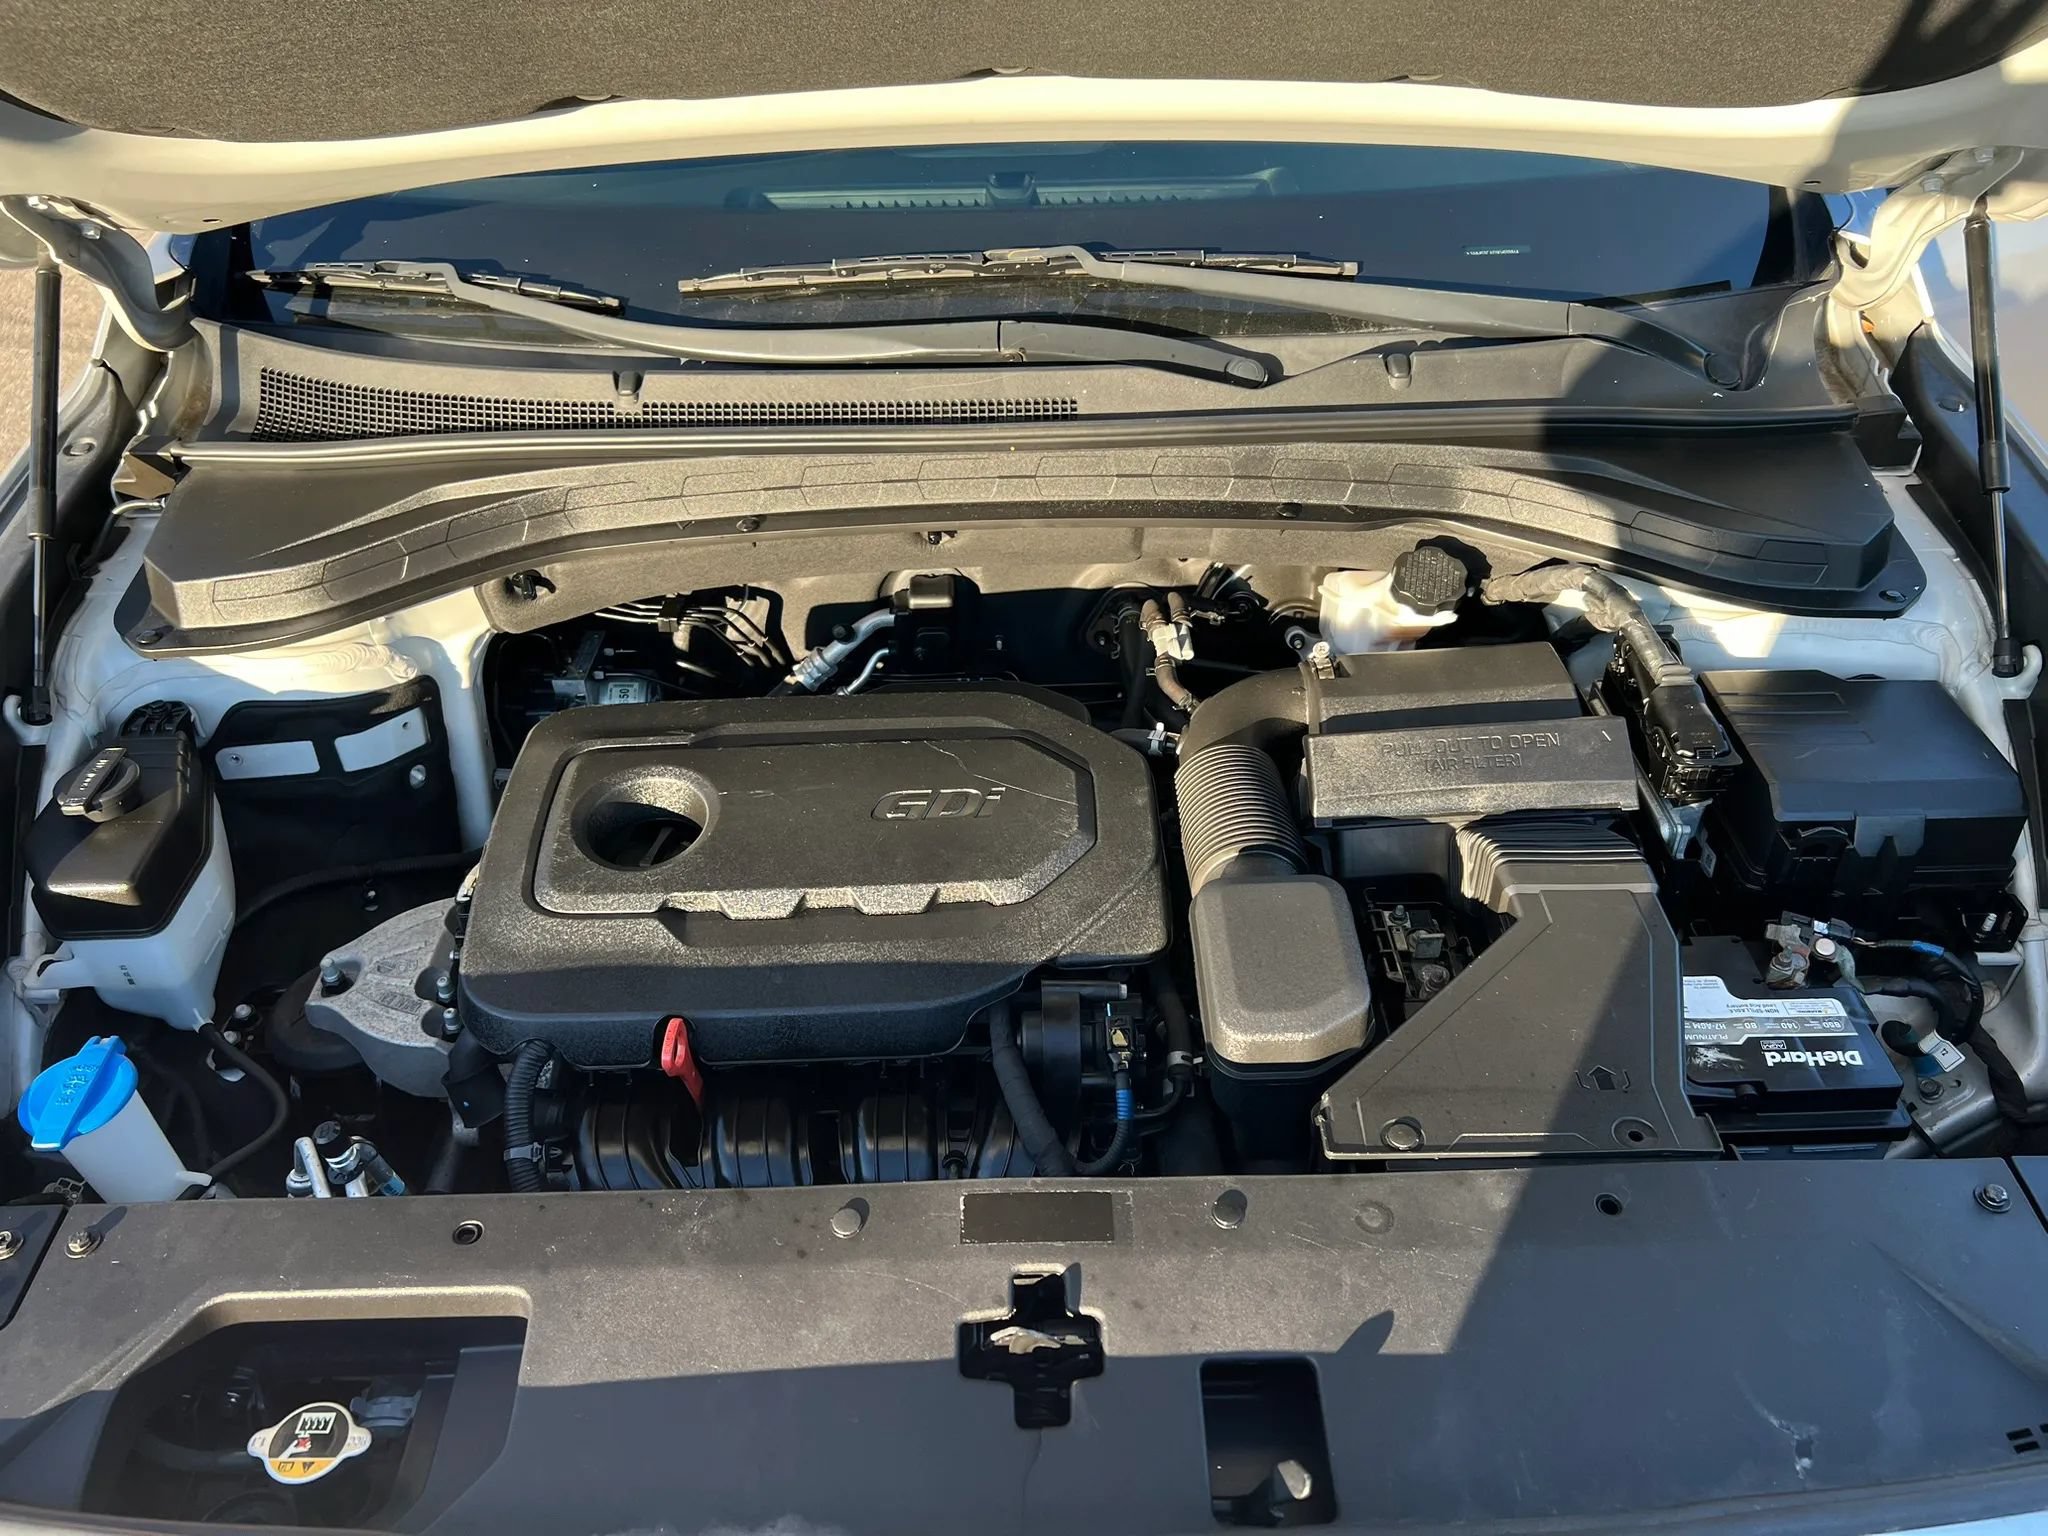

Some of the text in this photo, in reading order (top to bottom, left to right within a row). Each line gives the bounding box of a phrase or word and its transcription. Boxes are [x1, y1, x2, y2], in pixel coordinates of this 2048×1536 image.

[1433, 737, 1474, 753] OUT
[1477, 735, 1503, 750] TO
[1507, 732, 1562, 749] OPEN
[1684, 1033, 1729, 1041] PLATINUM
[1764, 1050, 1864, 1067] DieHard
